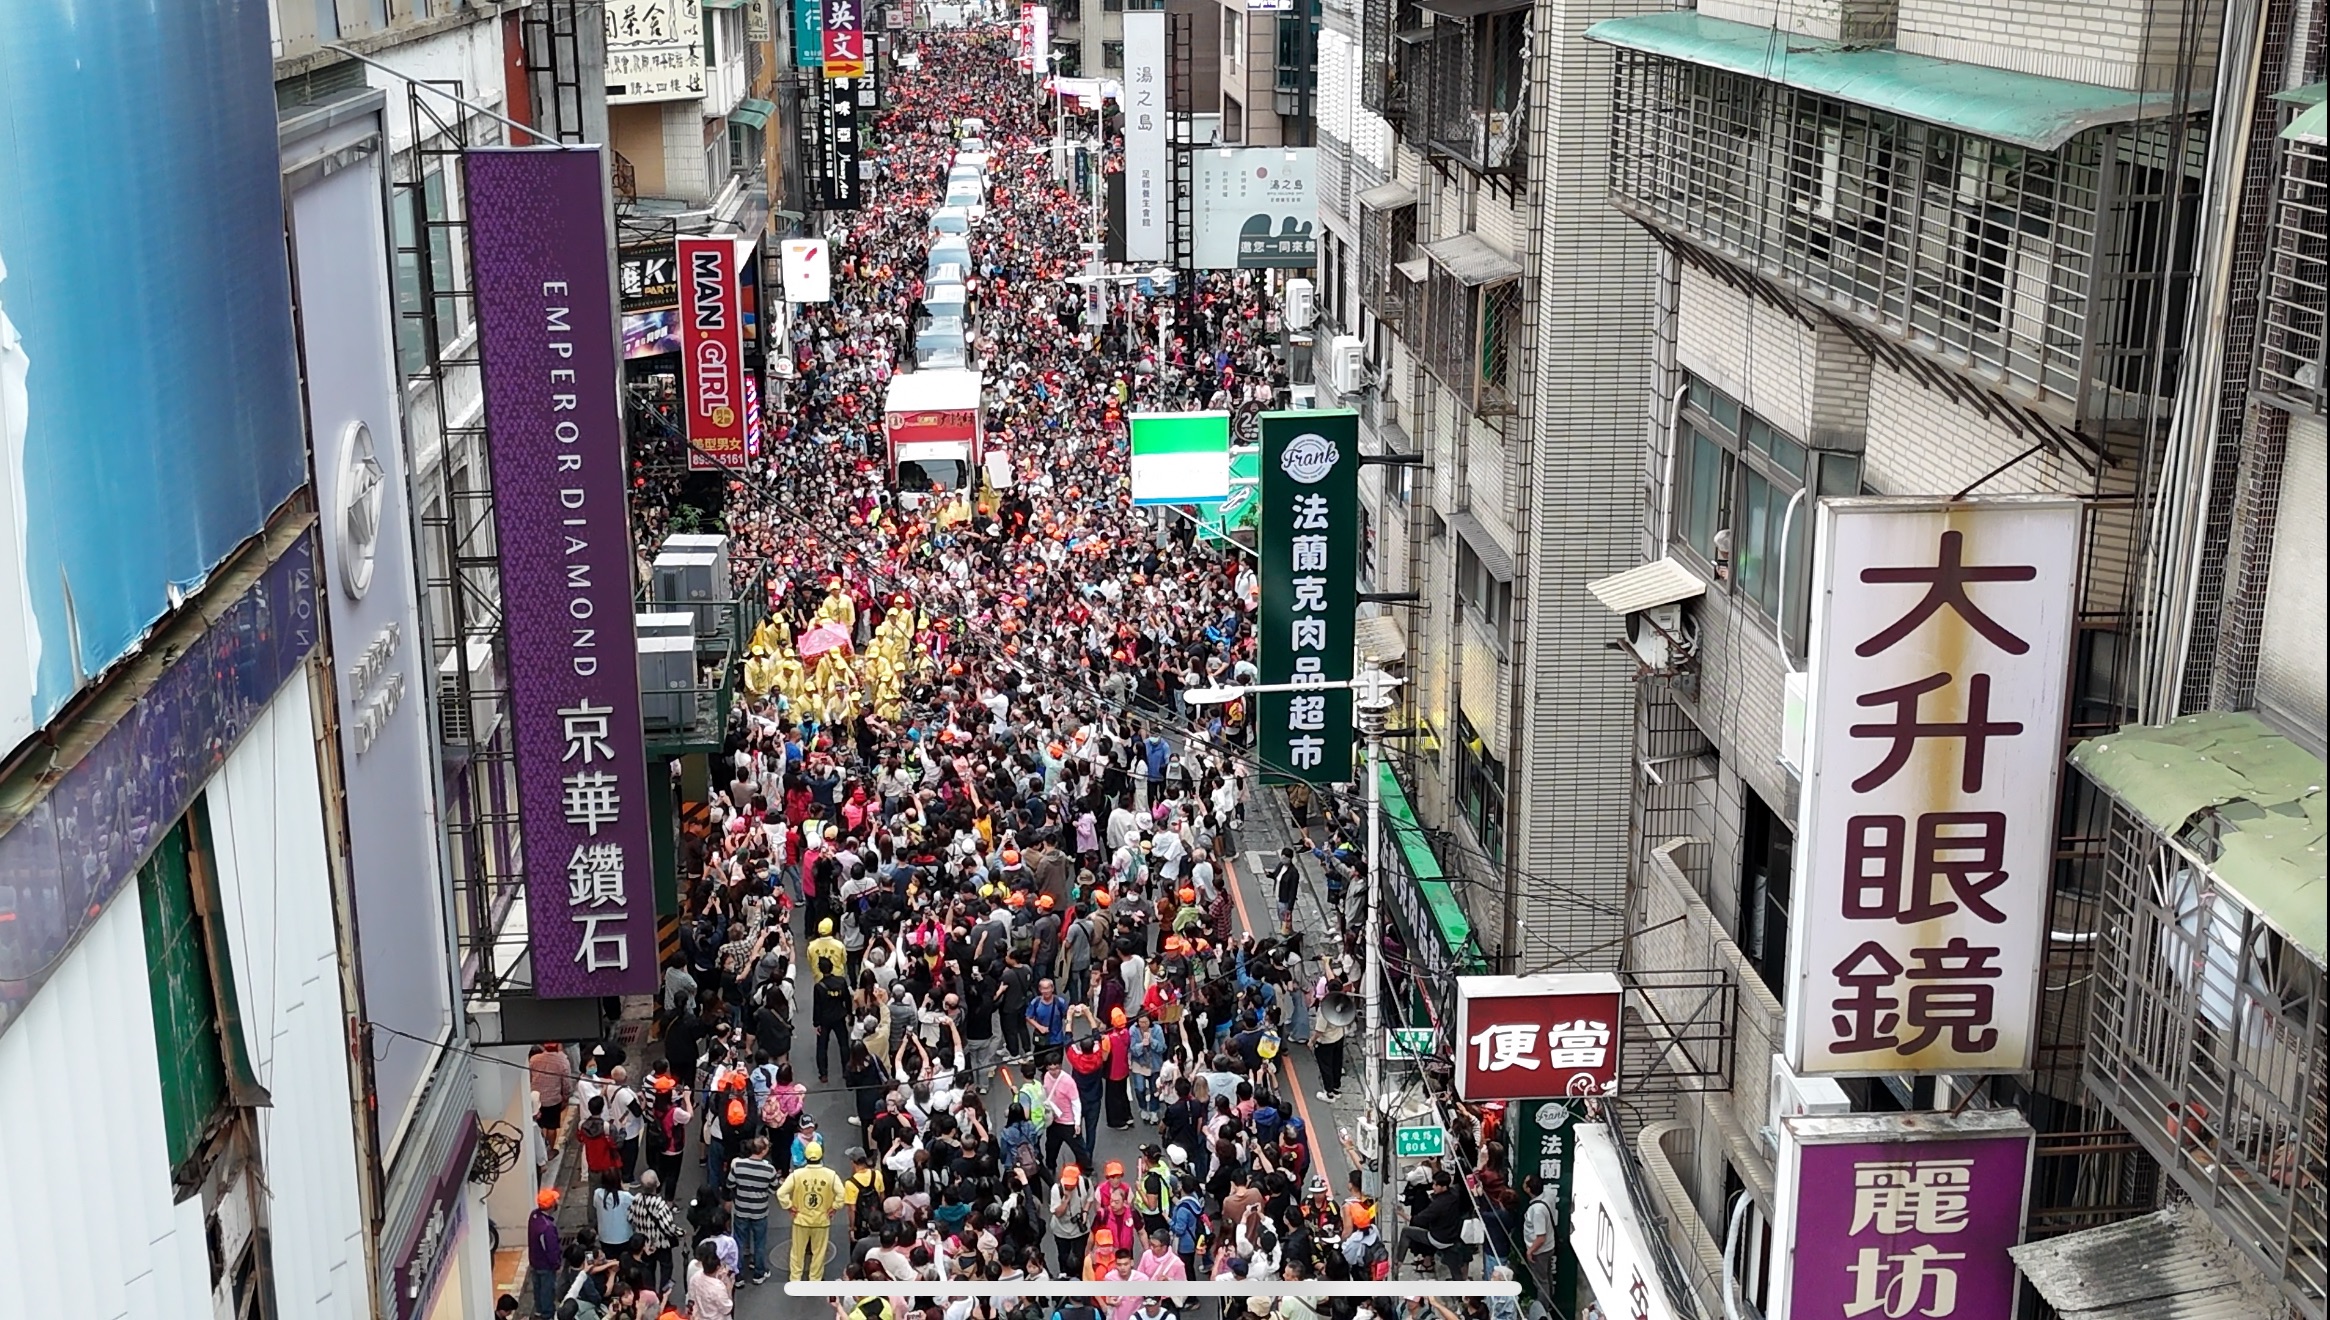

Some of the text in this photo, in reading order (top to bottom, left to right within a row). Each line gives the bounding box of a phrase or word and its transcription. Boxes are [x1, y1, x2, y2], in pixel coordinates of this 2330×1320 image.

[828, 1, 859, 60] 英文
[1136, 66, 1153, 132] 湯之島
[644, 283, 677, 295] PARTY
[543, 279, 596, 678] EMPEROR DIAMOND
[1283, 442, 1337, 469] Frank
[1288, 493, 1330, 770] 法蘭克肉品超市
[555, 698, 630, 973] 京華鑽石
[1829, 530, 2037, 1056] 大升眼鏡
[1470, 1019, 1611, 1072] 便當
[1842, 1160, 1976, 1320] 麗坊
